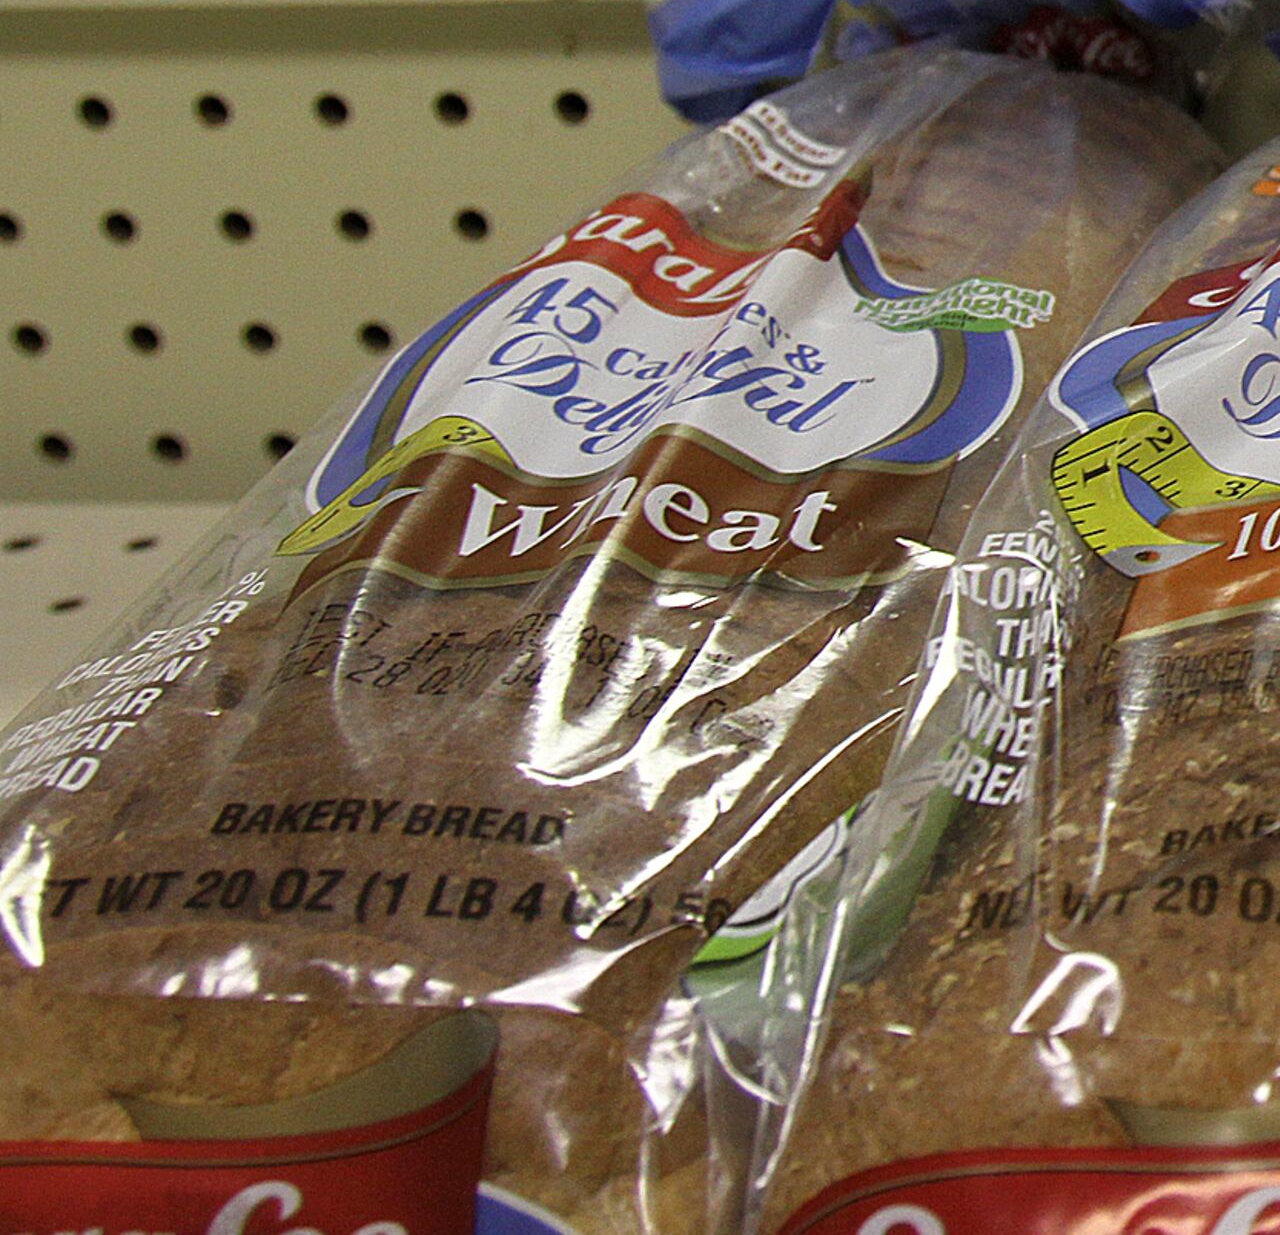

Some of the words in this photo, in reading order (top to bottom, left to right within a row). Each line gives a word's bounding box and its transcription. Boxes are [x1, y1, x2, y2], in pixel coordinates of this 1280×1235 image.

[510, 277, 620, 345] 45
[785, 343, 829, 376] &
[942, 739, 1030, 807] BREA
[210, 799, 399, 838] BAKERY
[403, 801, 567, 847] BREAD
[97, 869, 182, 917] WT
[184, 870, 249, 912] 20
[268, 870, 346, 914] OZ
[354, 873, 407, 923] (1
[425, 875, 495, 922] LB
[511, 880, 542, 920] 4
[1059, 879, 1135, 926] WT
[1152, 874, 1220, 918] 20
